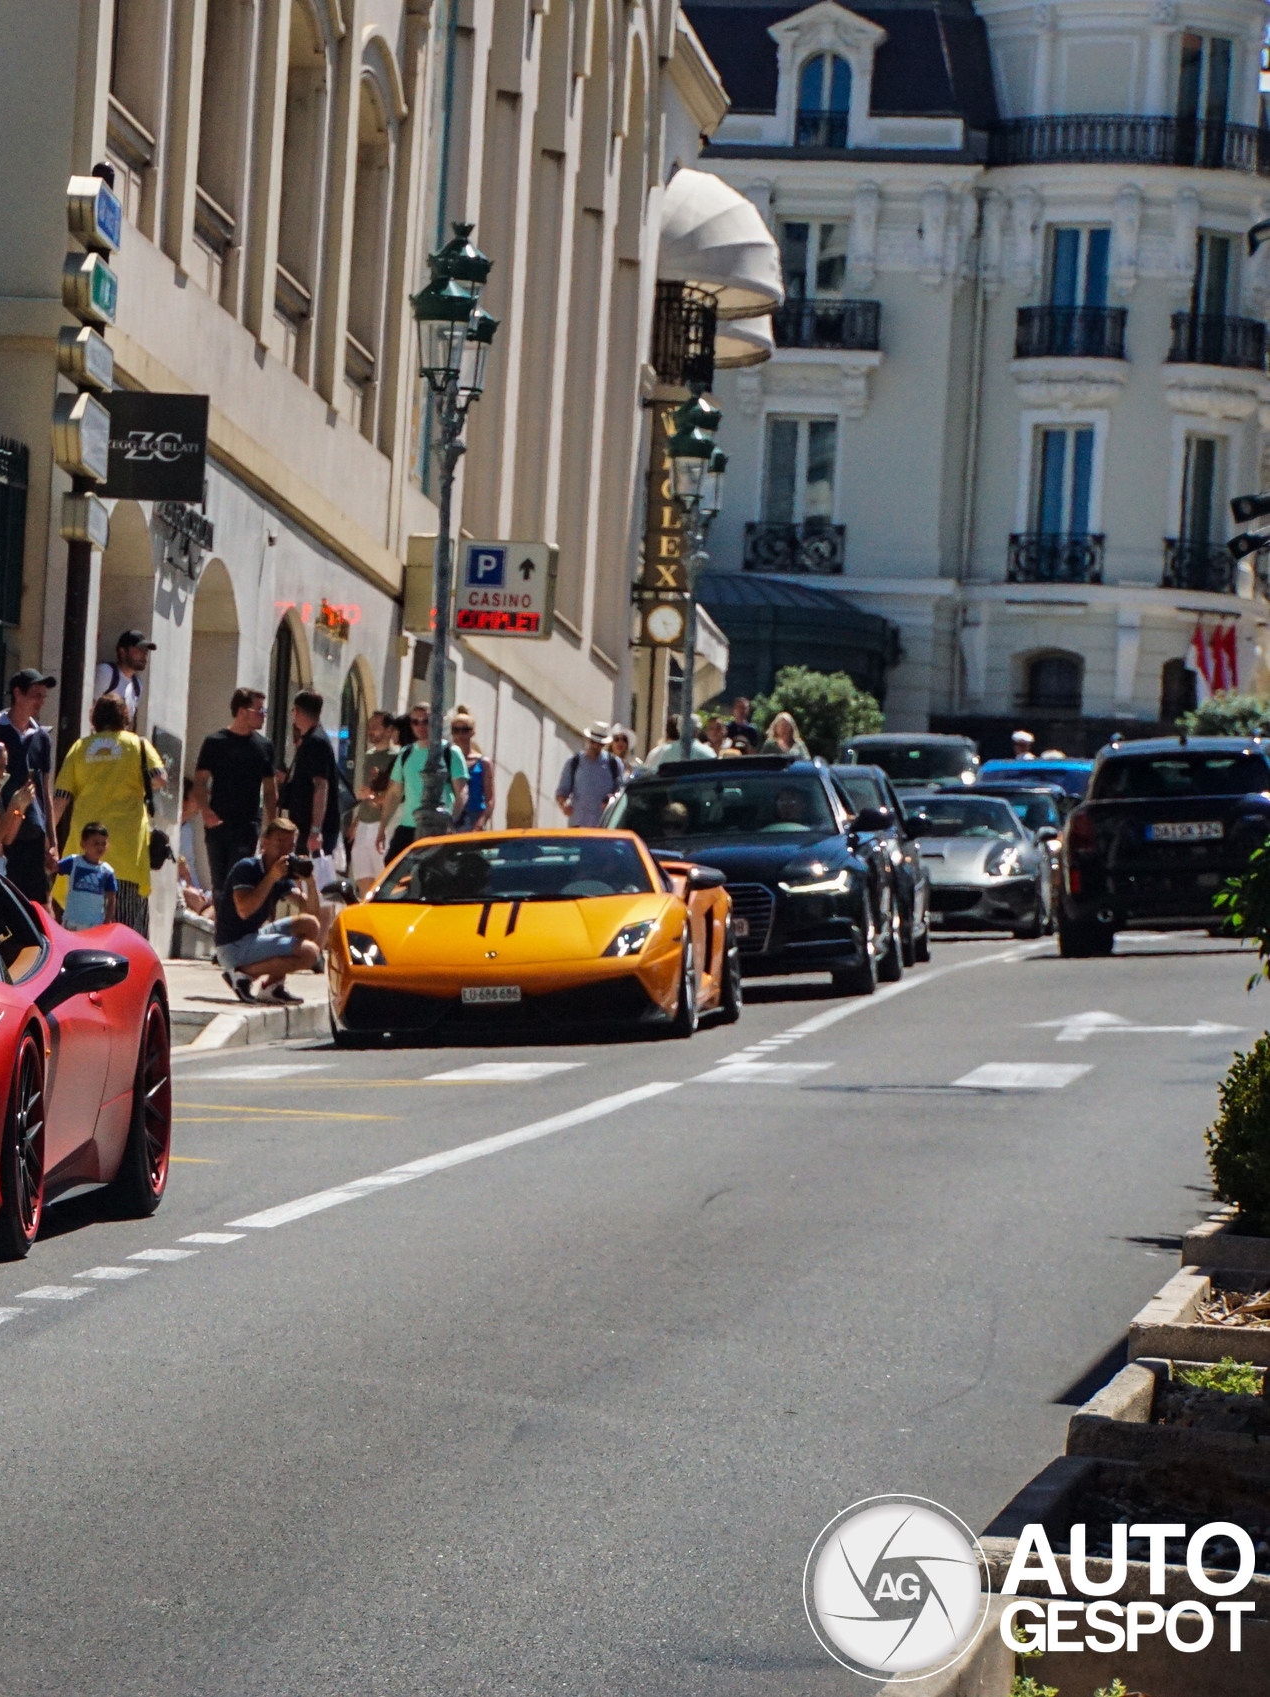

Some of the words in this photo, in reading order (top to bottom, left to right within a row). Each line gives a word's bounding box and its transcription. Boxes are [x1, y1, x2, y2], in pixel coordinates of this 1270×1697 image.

[477, 554, 497, 579] P
[468, 591, 532, 608] CASINO
[457, 609, 541, 632] COMPLET
